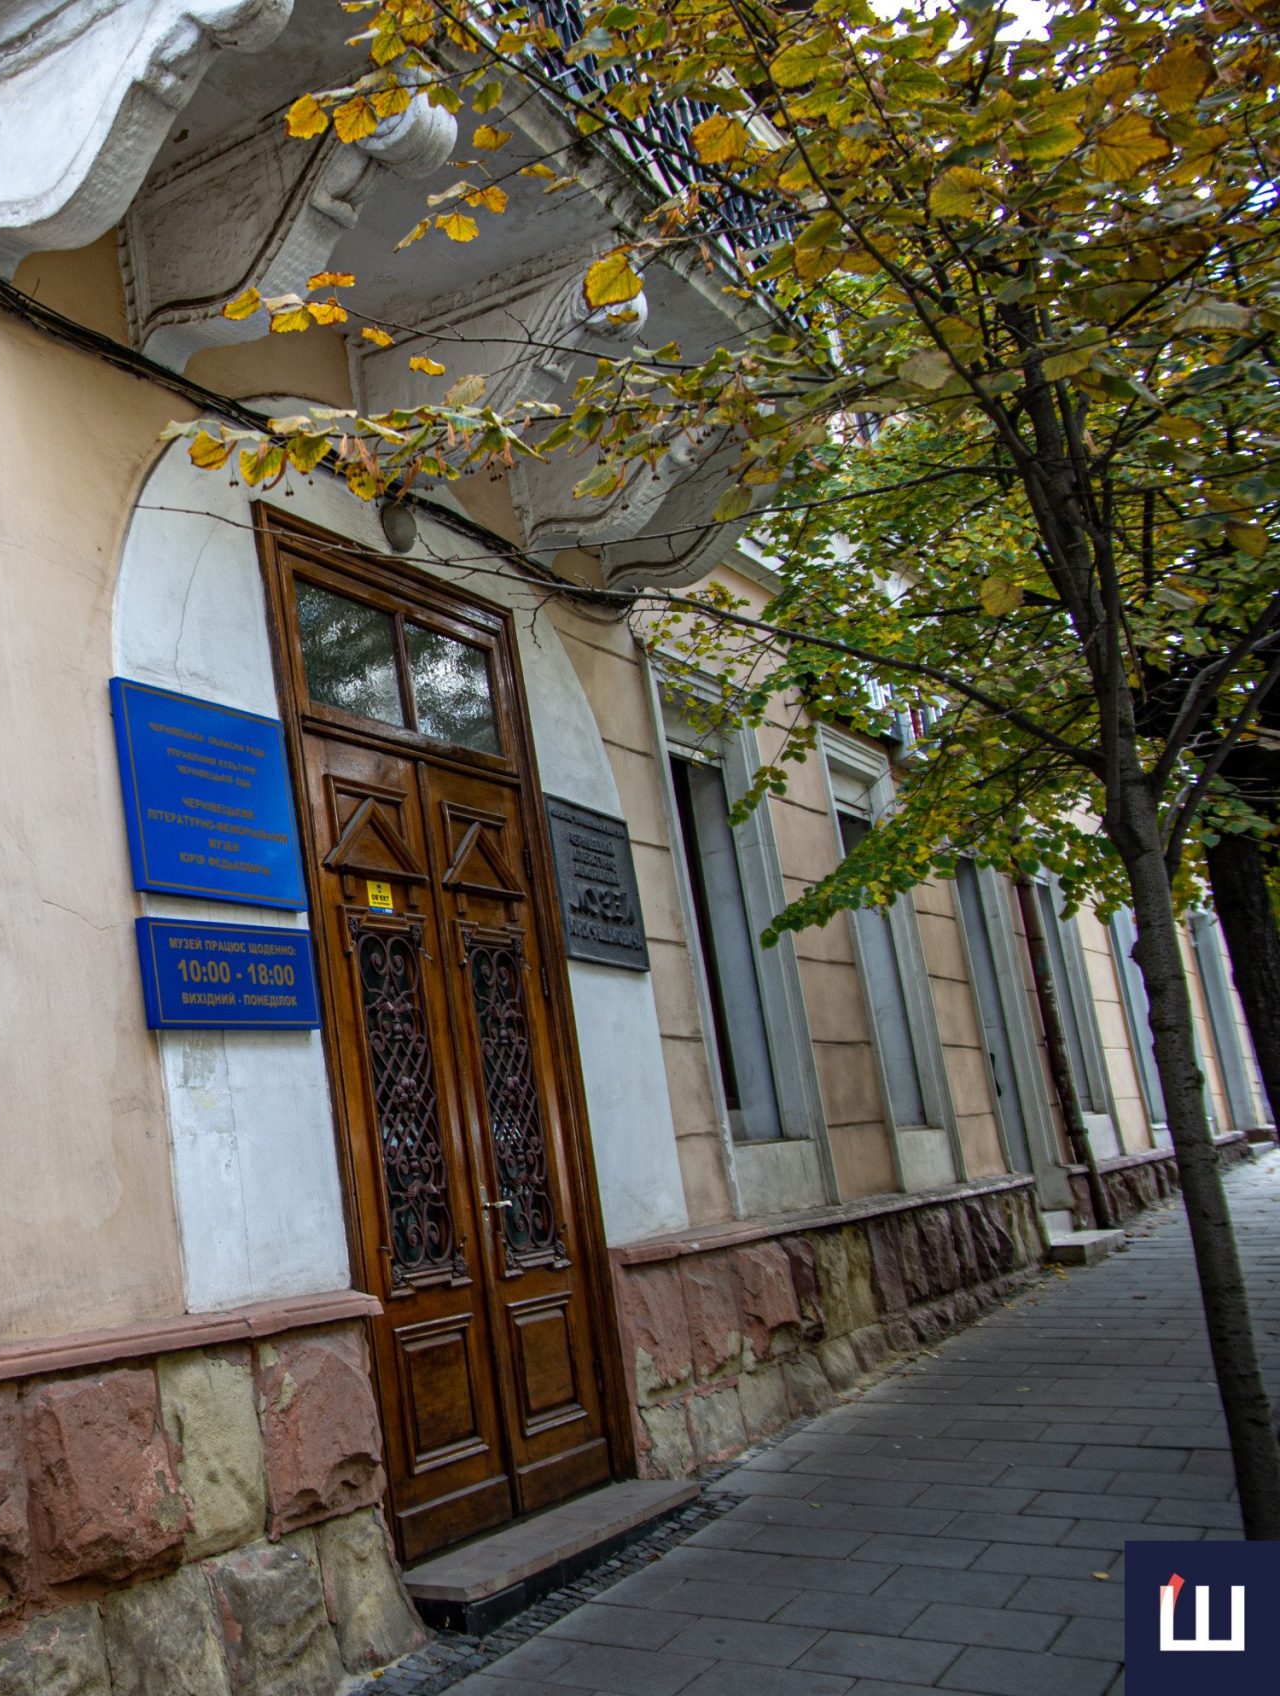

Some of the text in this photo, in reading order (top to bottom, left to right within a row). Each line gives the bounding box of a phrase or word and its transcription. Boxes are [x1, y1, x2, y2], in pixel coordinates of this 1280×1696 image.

[169, 936, 297, 956] МУЗЕЙ ПРАЦЮЄ ЩОДЕННО:
[178, 959, 231, 984] 10:00
[248, 963, 295, 986] 18:00
[182, 991, 236, 1006] ВИХІДНИЙ
[243, 994, 298, 1008] ПОНЕДІЛОК
